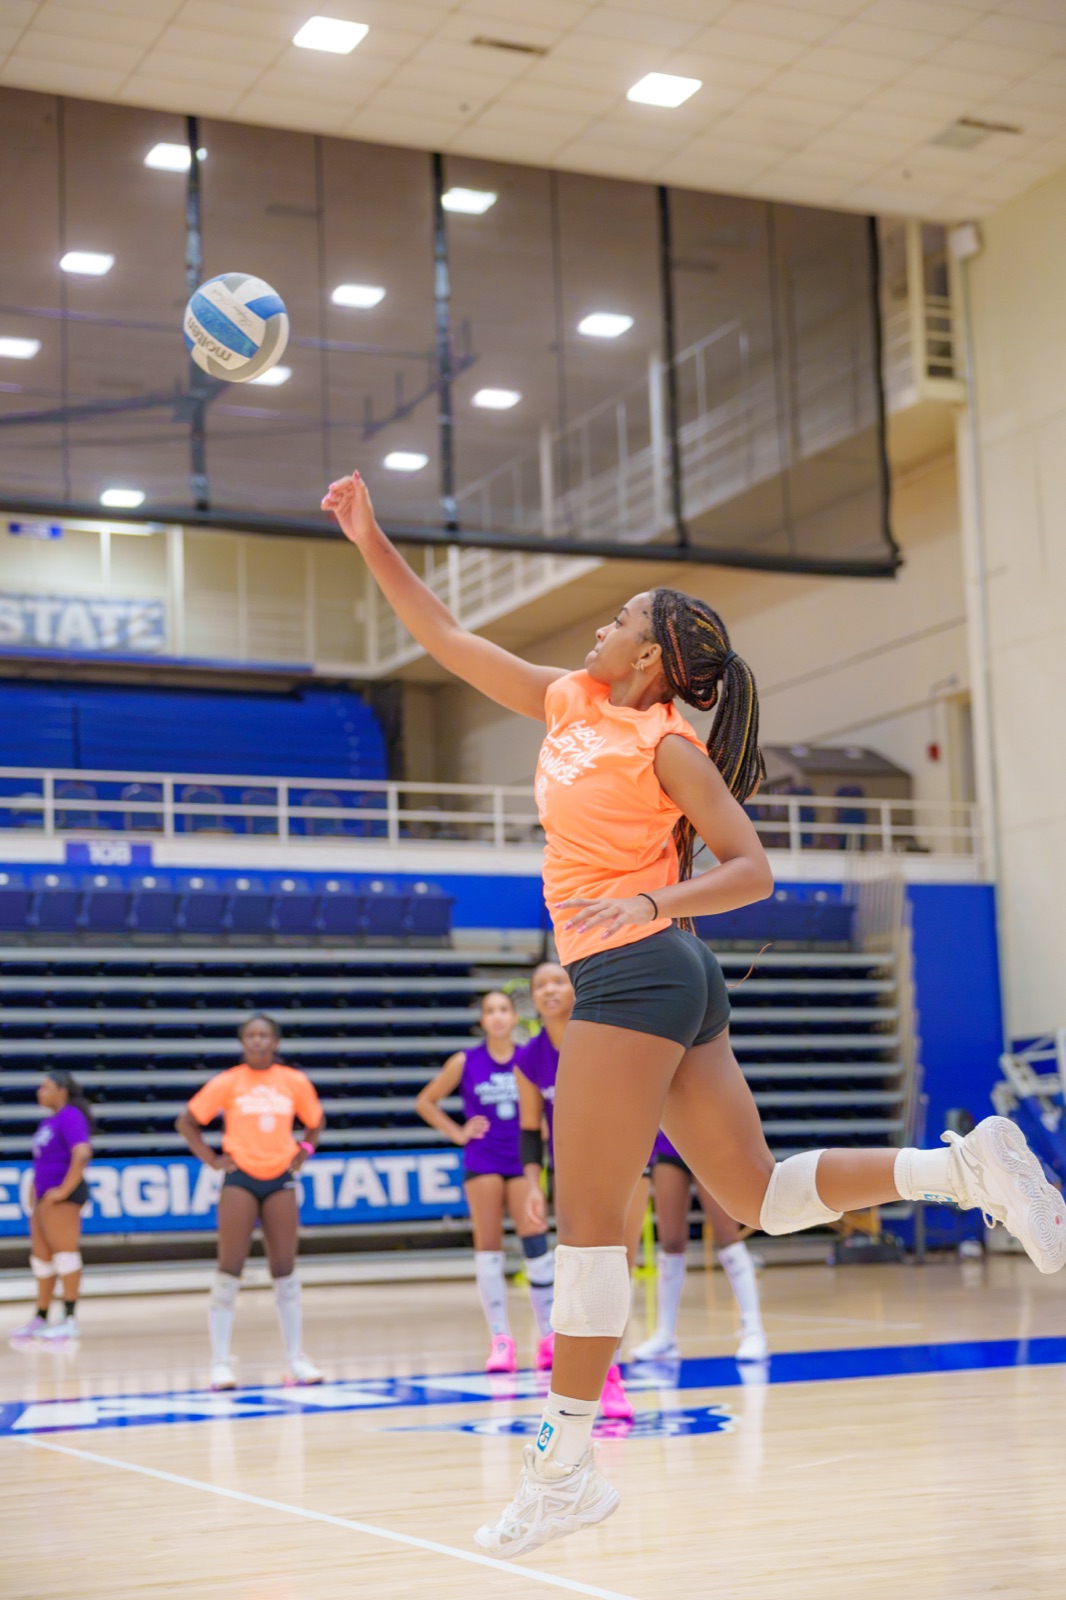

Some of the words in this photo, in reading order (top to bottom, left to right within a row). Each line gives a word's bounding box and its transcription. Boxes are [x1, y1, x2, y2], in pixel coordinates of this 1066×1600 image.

[187, 317, 232, 361] molten
[0, 600, 164, 649] STATE
[293, 1153, 461, 1209] TATE
